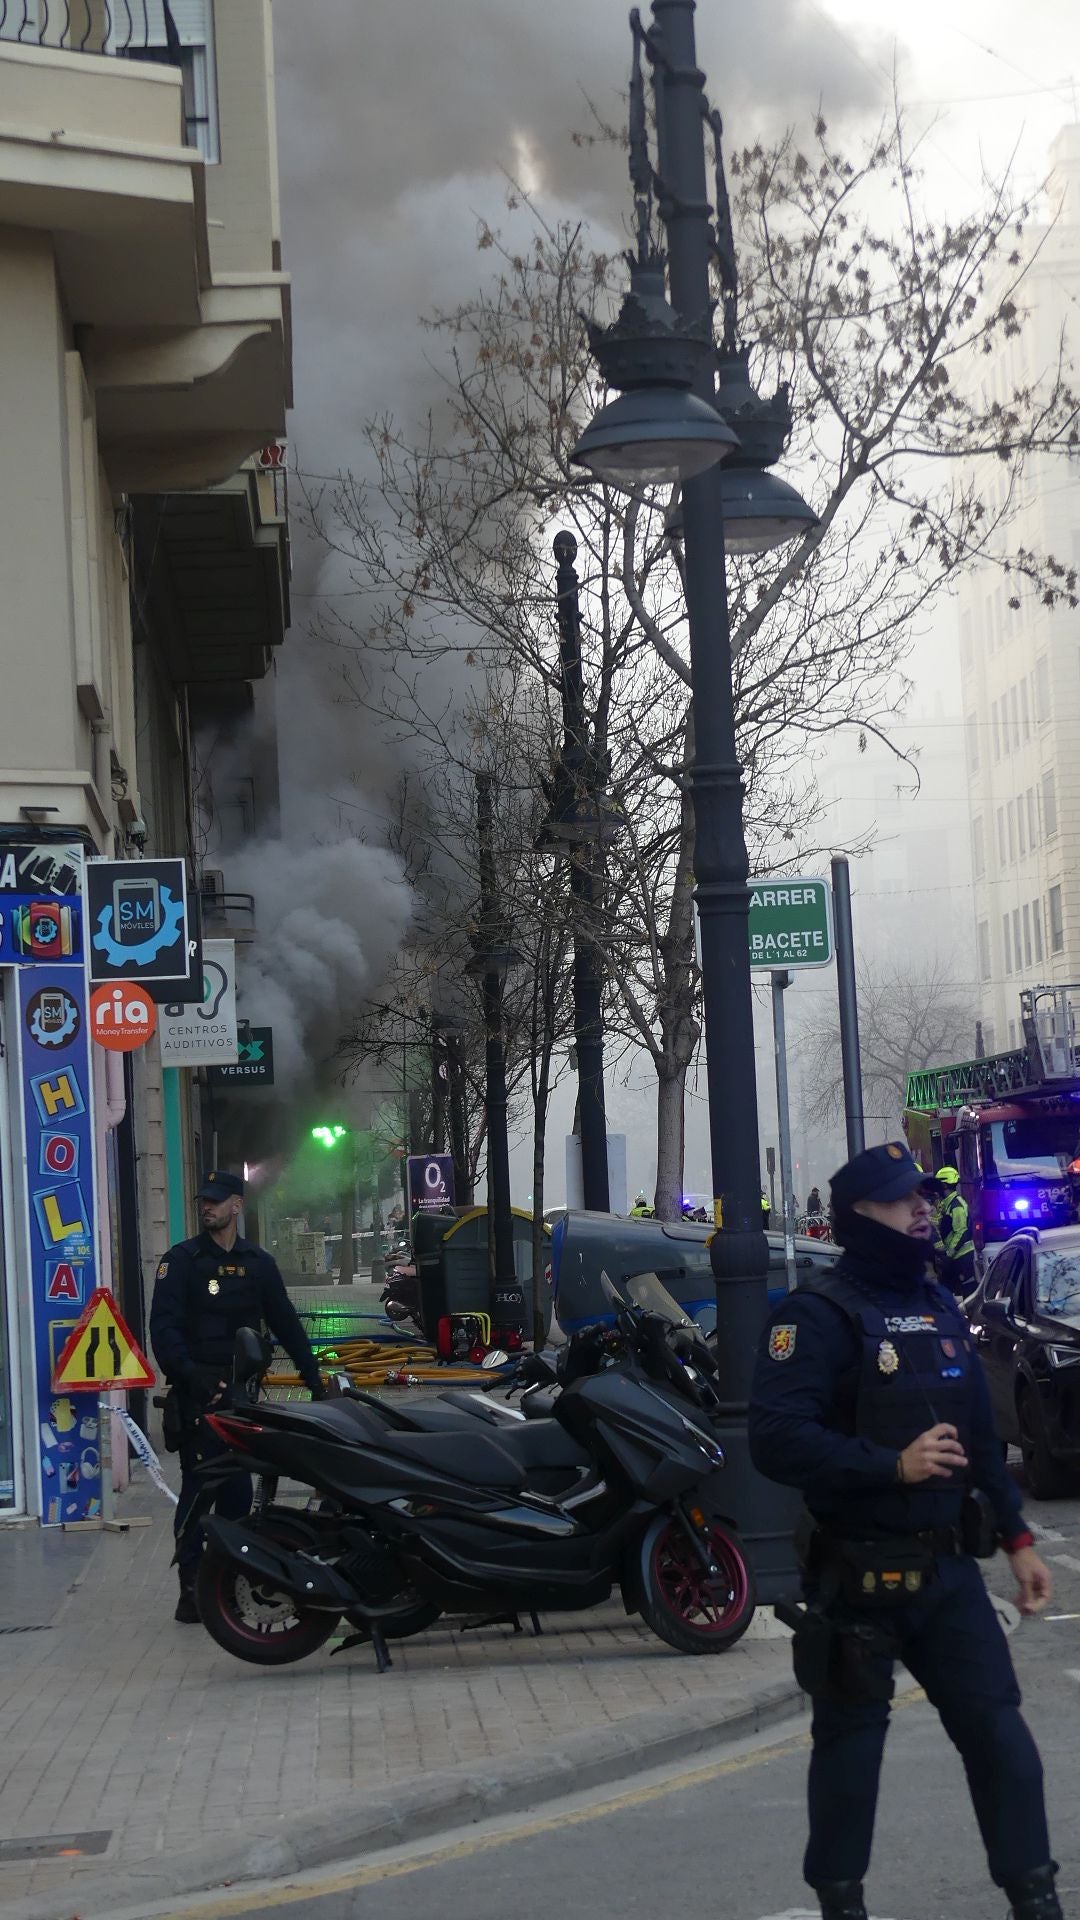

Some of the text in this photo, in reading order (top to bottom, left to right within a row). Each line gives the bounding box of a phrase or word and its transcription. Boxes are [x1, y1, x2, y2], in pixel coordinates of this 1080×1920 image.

[749, 889, 816, 907] ARRER
[120, 901, 154, 920] SM
[749, 931, 824, 950] BACETE
[44, 1006, 62, 1018] SM
[96, 989, 149, 1024] ria
[168, 1025, 227, 1036] CENTROS
[164, 1038, 233, 1049] AUDITIVOS
[221, 1066, 266, 1075] VERSUS
